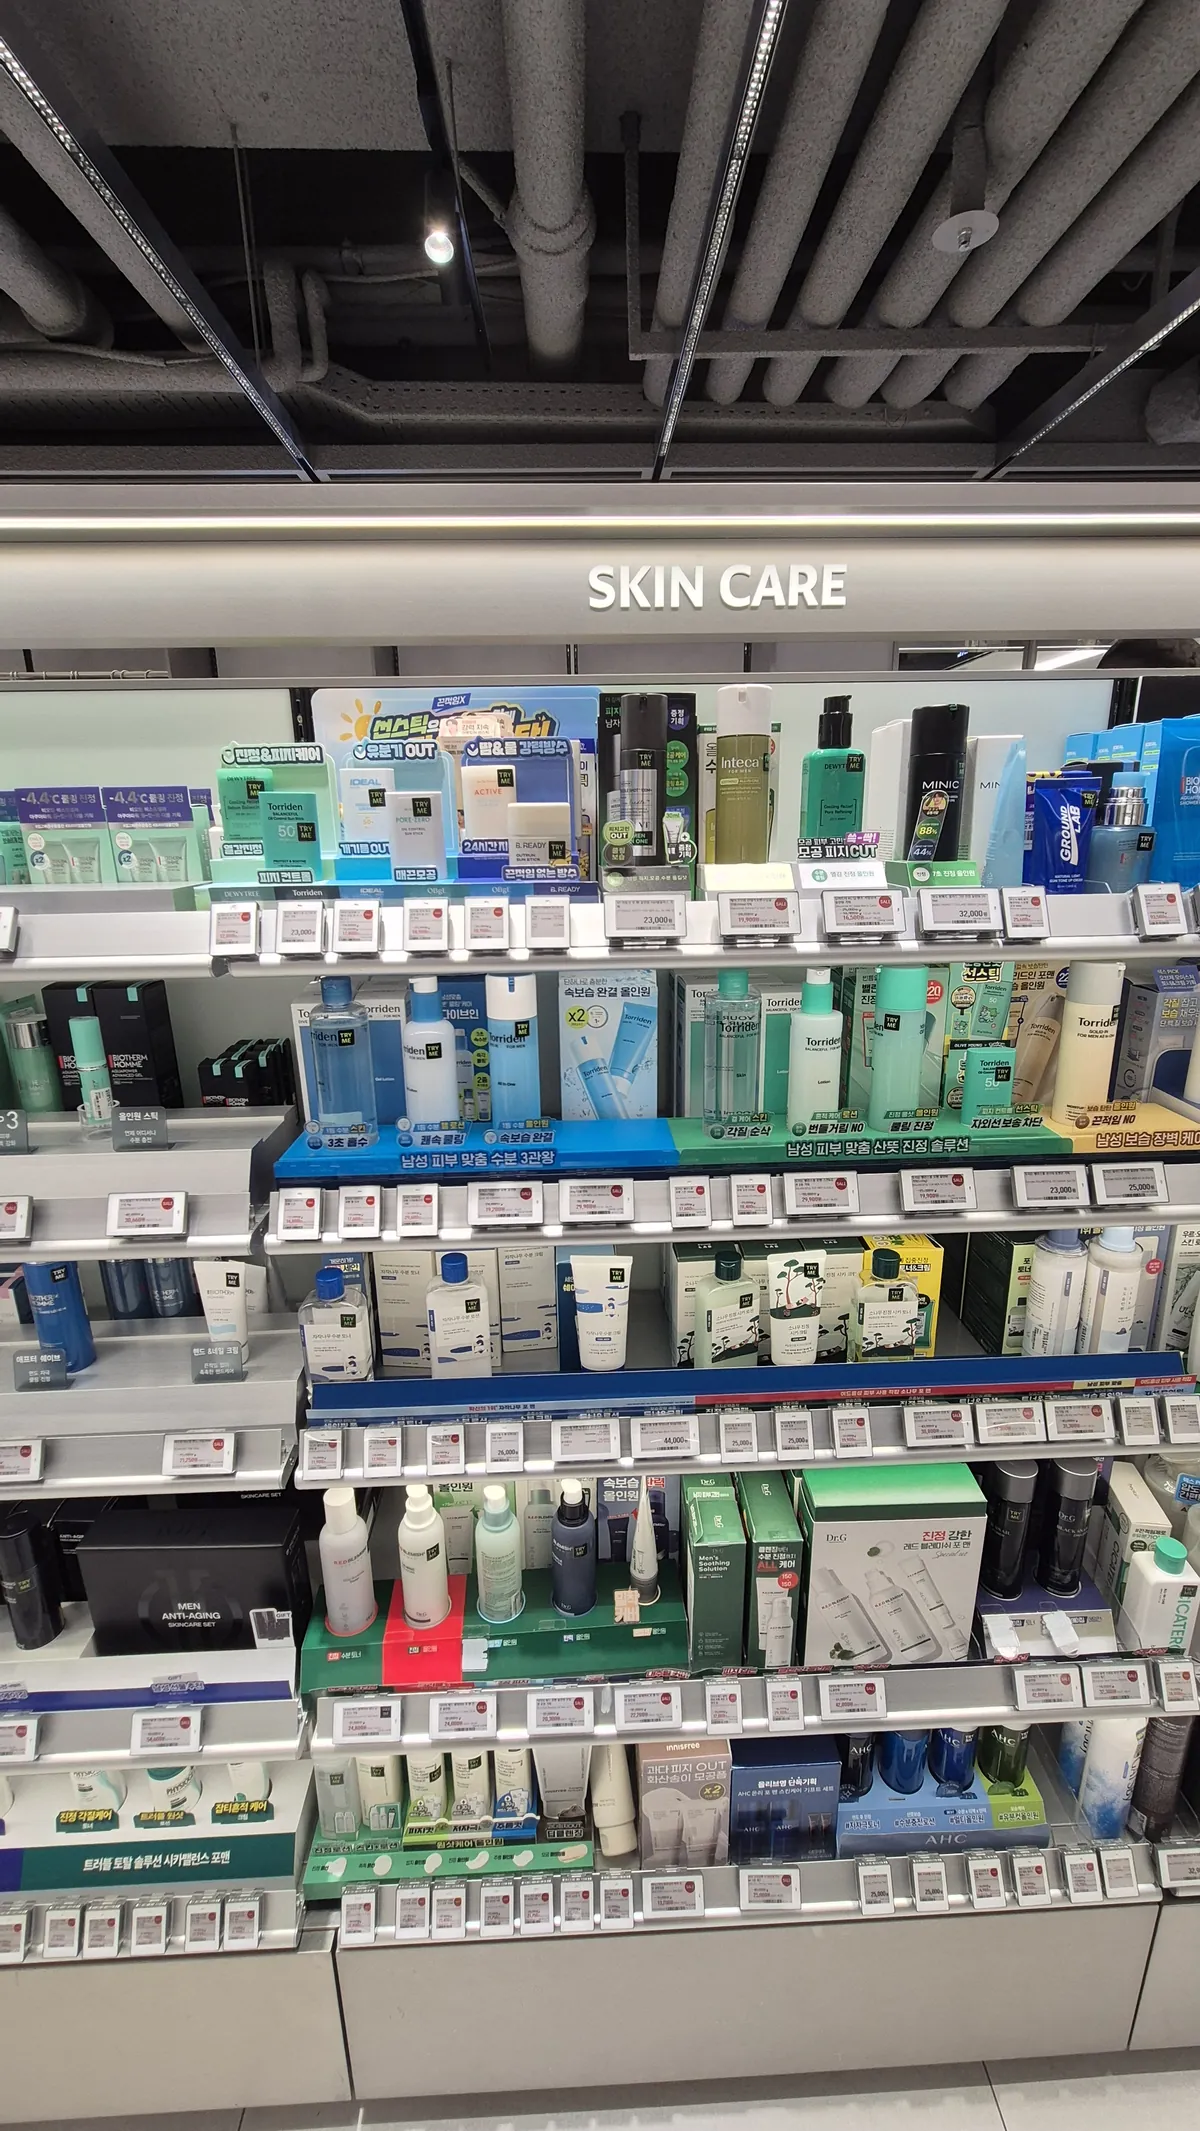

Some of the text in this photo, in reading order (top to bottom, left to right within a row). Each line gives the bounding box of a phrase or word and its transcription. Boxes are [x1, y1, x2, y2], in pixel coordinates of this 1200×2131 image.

[588, 563, 849, 611] SKIN CARE
[670, 708, 684, 717] 증정
[670, 717, 684, 726] 기획
[366, 743, 435, 759] 유분기 OUT
[720, 756, 760, 769] Inteca
[349, 779, 381, 787] IDEAL
[921, 780, 960, 790] MINIC
[473, 788, 503, 796] ACTIVE
[61, 793, 78, 805] 쿨링
[79, 793, 96, 805] 진정
[149, 793, 166, 805] 쿨링
[167, 793, 184, 804] 진정
[266, 802, 303, 812] Torriden
[1073, 806, 1081, 834] LAB
[918, 826, 938, 835] 88%
[1060, 806, 1072, 861] GROUND
[797, 838, 812, 846] 모공
[259, 870, 312, 883] 피지 컨트롤
[394, 868, 437, 880] 매끈모공
[504, 867, 577, 880] 끈적임 없는 방수
[292, 888, 323, 898] Torriden
[962, 967, 1001, 982] 선스틱
[563, 987, 650, 999] 속보습 완결 올인원
[567, 1009, 585, 1023] x2
[623, 1013, 652, 1026] Torriden
[1161, 1009, 1178, 1019] 보습
[112, 1054, 149, 1062] BIOTHERM
[112, 1061, 144, 1069] HOMME
[118, 1111, 159, 1122] 올인원 스틱
[970, 1116, 1043, 1129] 자외선 보송 차단
[1091, 1114, 1136, 1126] 끈적임 NO
[726, 1125, 771, 1137] 각질 순삭
[807, 1122, 864, 1134] 번들거림 NO
[913, 1120, 935, 1132] 진정
[327, 1138, 344, 1148] 3초
[500, 1132, 554, 1144] 속보습 완결
[1095, 1134, 1123, 1148] 남성
[1125, 1133, 1151, 1147] 보습
[1153, 1131, 1180, 1146] 장벽
[787, 1138, 970, 1157] 남성 피부 맞춤 산뜻 진정 솔루션
[402, 1151, 555, 1168] 남성 피부 맞춤 수분 3관왕
[16, 1355, 62, 1364] 애프터 쉐이브
[603, 1477, 640, 1489] 속보습
[603, 1490, 639, 1502] 올인원
[826, 1533, 847, 1542] Dr.G
[922, 1530, 973, 1542] 진정 강한
[920, 1542, 951, 1550] 블레미쉬
[962, 1541, 971, 1549] 맨
[757, 1560, 796, 1570] ALL 케어
[178, 1602, 201, 1611] MEN
[162, 1611, 221, 1621] ANTI-AGING
[850, 1744, 872, 1755] AHC
[646, 1760, 727, 1774] 과다 피지 OUT
[646, 1771, 727, 1784] 화산송이 모공폼
[757, 1779, 787, 1789] 올리브영
[215, 1801, 267, 1814] 잡티흔적 케어
[59, 1810, 113, 1823] 진정 각질케어
[925, 1834, 967, 1845] AHC
[83, 1850, 231, 1871] 트러블 토탈 솔루션 시카밸런스 포맨
